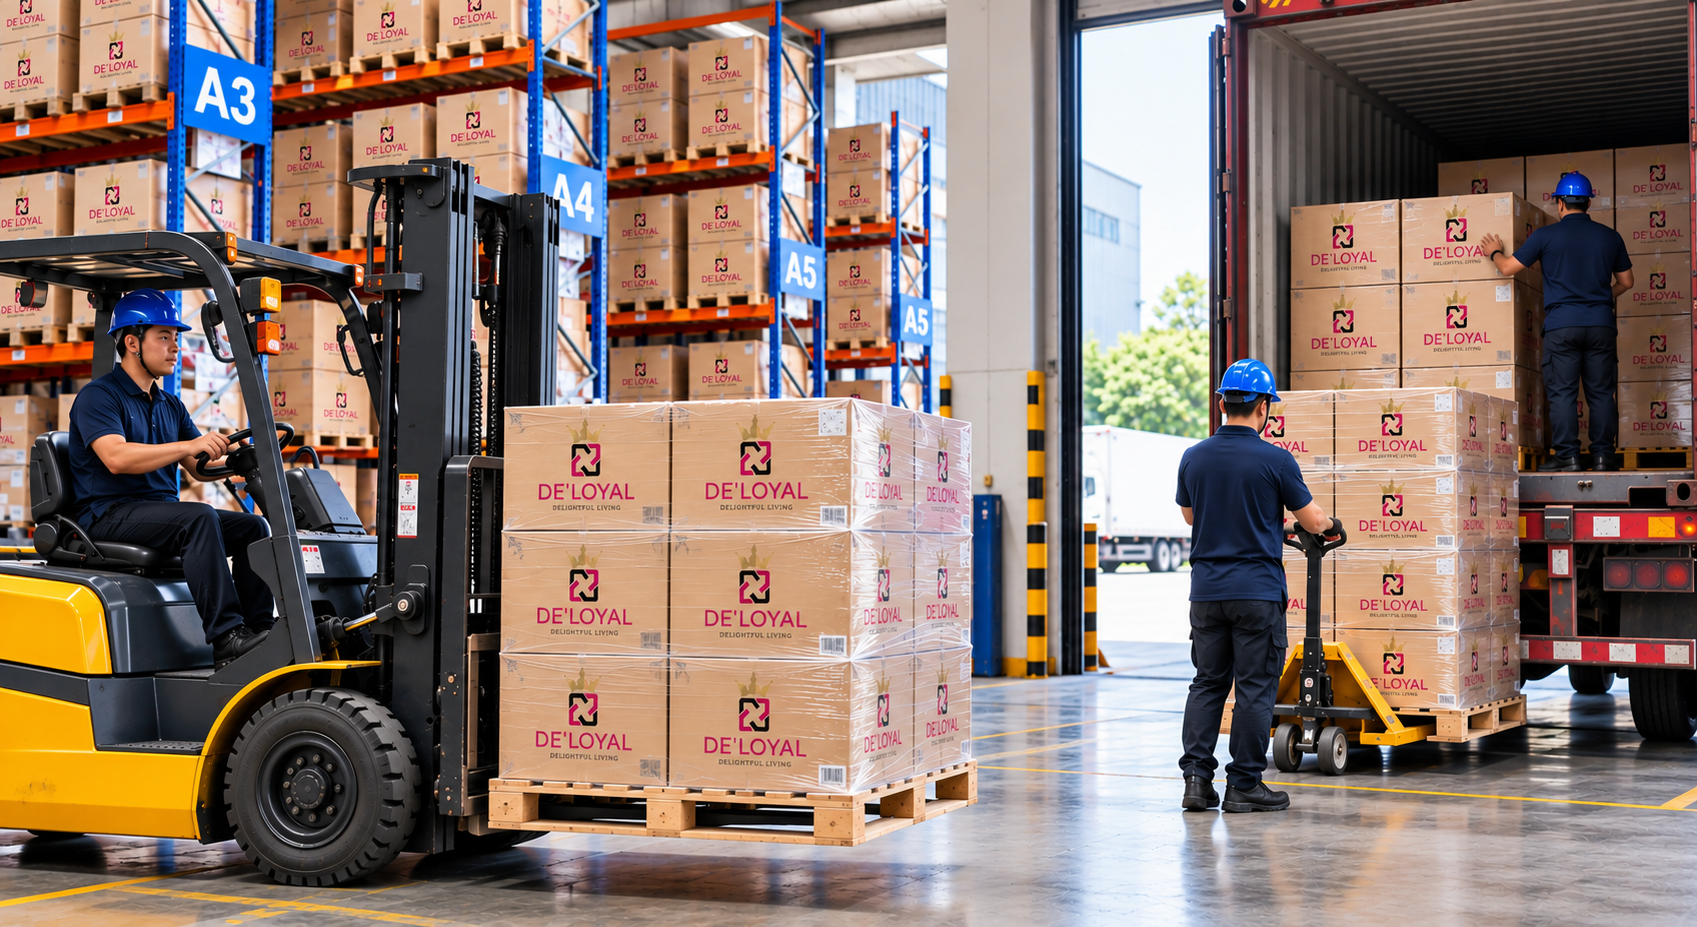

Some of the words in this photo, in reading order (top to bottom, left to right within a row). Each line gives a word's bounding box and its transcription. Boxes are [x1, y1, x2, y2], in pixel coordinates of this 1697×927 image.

[4, 76, 44, 90] DELOYAL
[194, 66, 256, 125] A3
[553, 173, 595, 223] A4
[1311, 251, 1377, 266] DE'LOYAL
[785, 251, 817, 289] A5
[903, 305, 929, 337] A5
[1311, 336, 1377, 349] DE'LOYAL
[1423, 332, 1491, 345] DE'LOYAL
[1272, 441, 1309, 453] OYAL
[1358, 440, 1427, 452] DE'LOYAL
[539, 483, 635, 500] DE'LOYAL
[705, 482, 809, 500] DE'LOYAL
[1359, 520, 1428, 532] DE'LOYAL
[1360, 599, 1428, 611] DE'LOYAL
[537, 607, 633, 625] DE'LOYAL
[704, 610, 808, 628] DE'LOYAL
[550, 628, 592, 636] DELIGHTFUL
[594, 629, 619, 637] LIVING
[1371, 678, 1428, 690] E'LOYAL
[535, 731, 633, 751] DE'LOYAL
[704, 737, 807, 757] DE'LOYAL
[550, 752, 592, 760] DELIGHTFUL
[593, 754, 619, 762] LIVING
[718, 758, 763, 767] DELIGHTFUL
[765, 760, 792, 768] LIVING
